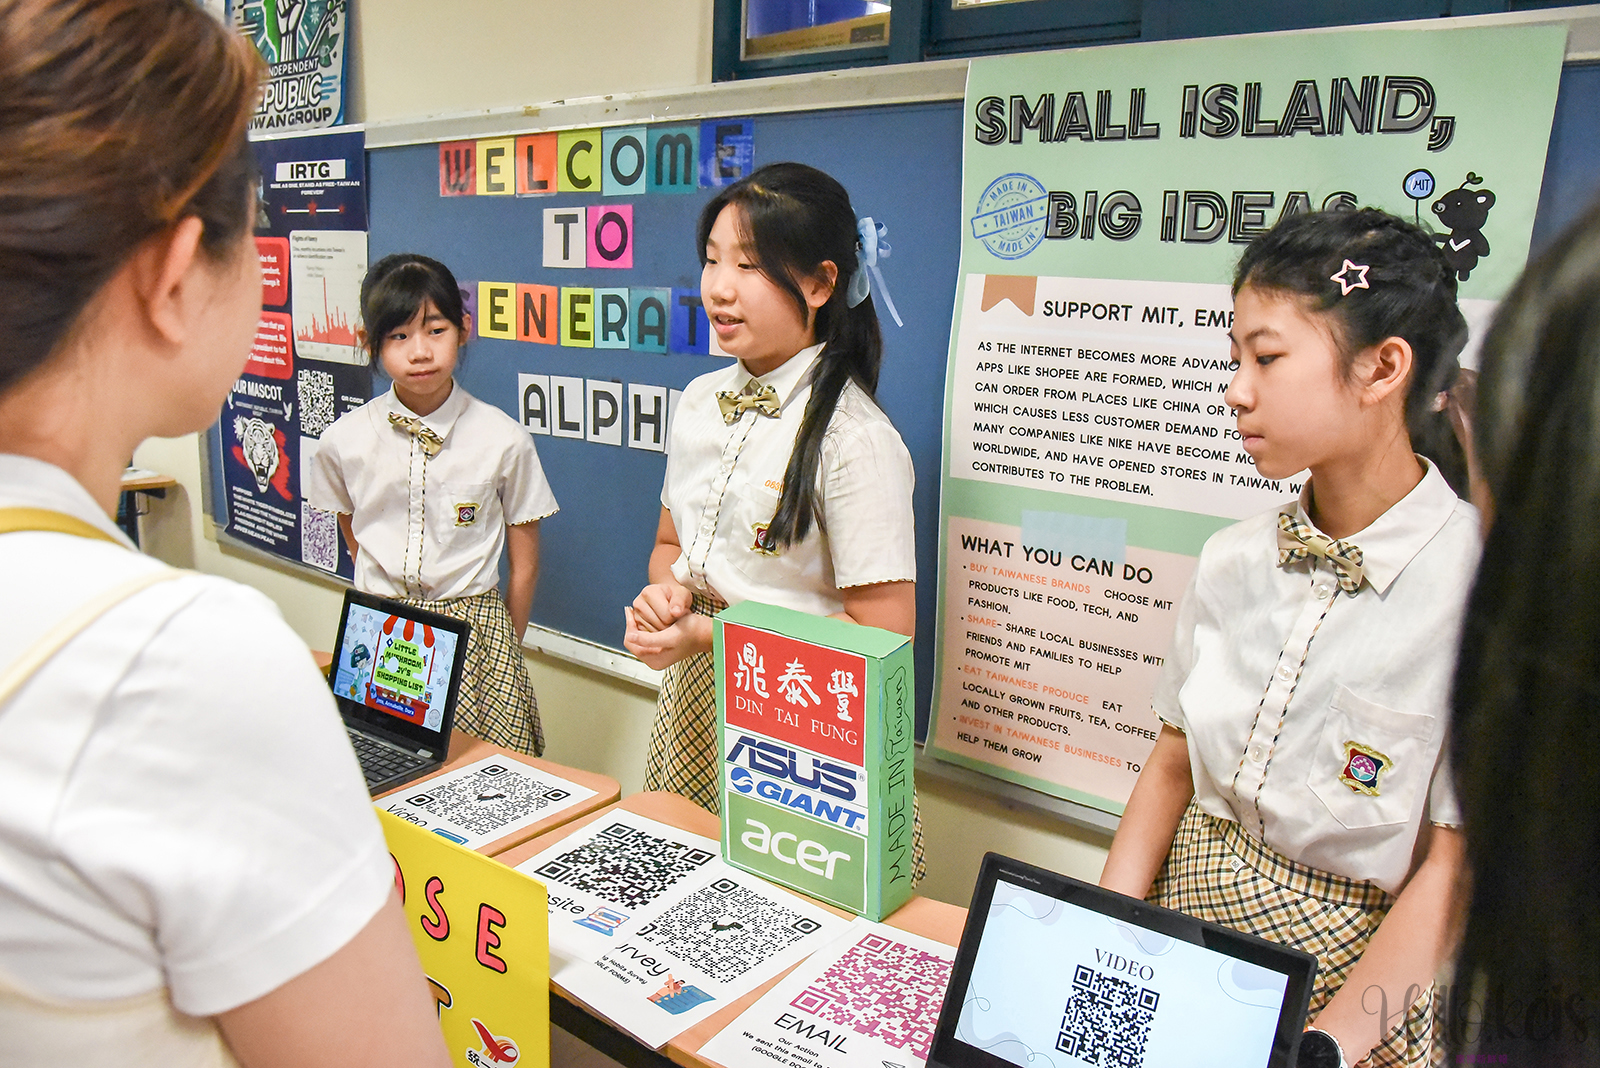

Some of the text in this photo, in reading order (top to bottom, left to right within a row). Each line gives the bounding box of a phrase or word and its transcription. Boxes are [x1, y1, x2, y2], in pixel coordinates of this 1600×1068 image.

[288, 107, 332, 126] GROUP
[975, 75, 1456, 152] SMALL ISLAND,
[290, 161, 331, 179] IRTG
[443, 124, 743, 192] WELCOME
[990, 181, 1027, 201] MADE IN
[1413, 178, 1430, 191] MIT
[993, 205, 1034, 228] TAIWAN
[1045, 189, 1143, 242] BIG
[554, 211, 628, 261] TO
[998, 231, 1036, 252] MADE IN
[460, 288, 703, 348] ENERAT
[1043, 300, 1133, 323] SUPPORT
[1142, 306, 1184, 328] MIT,
[978, 341, 992, 352] AS
[996, 342, 1017, 354] THE
[1020, 344, 1072, 359] INTERNET
[1077, 348, 1136, 364] BECOMES
[1140, 354, 1177, 367] MORE
[247, 381, 283, 401] MASCOT
[976, 361, 1004, 373] APPS
[1008, 364, 1031, 376] LIKE
[1035, 366, 1080, 380] SHOPEE
[1084, 370, 1108, 383] ARE
[1112, 373, 1166, 390] FORMED,
[1171, 379, 1212, 393] WHICH
[523, 383, 662, 444] ALPH
[975, 382, 999, 393] CAN
[1002, 385, 1039, 398] ORDER
[1043, 387, 1077, 401] FROM
[1081, 391, 1128, 406] PLACES
[1133, 397, 1157, 409] LIKE
[1162, 399, 1201, 413] CHINA
[1206, 404, 1225, 416] OR
[974, 402, 1009, 415] WHICH
[1013, 405, 1058, 420] CAUSES
[1062, 410, 1089, 423] LESS
[1094, 414, 1160, 431] CUSTOMER
[1165, 422, 1219, 439] DEMAND
[973, 421, 1005, 434] MANY
[1009, 425, 1075, 443] COMPANIES
[1080, 432, 1103, 446] LIKE
[1108, 435, 1132, 449] NIKE
[1137, 440, 1171, 455] HAVE
[1176, 445, 1230, 462] BECOME
[972, 461, 1154, 496] CONTRIBUTES TO THE PROBLEM.
[973, 441, 1040, 460] WORLDWIDE,
[1044, 450, 1068, 462] AND
[1072, 452, 1104, 467] HAVE
[1108, 458, 1155, 475] OPENED
[1160, 464, 1207, 481] STORES
[1212, 472, 1224, 483] IN
[1229, 474, 1283, 494] TAIWAN,
[961, 533, 1154, 585] WHAT YOU CAN DO
[968, 580, 1139, 623] PRODUCTS LIKE FOOD, TECH, AND
[969, 562, 1174, 611] BUY TAIWANESE BRANDS CHOOSE MIT
[968, 597, 1011, 615] FASHION.
[394, 643, 417, 656] LITTLE
[965, 648, 1031, 672] PROMOTE MIT
[966, 631, 1122, 676] FRIENDS AND FAMILIES TO HELP
[1005, 623, 1036, 638] SHARE
[1040, 630, 1074, 647] LOCAL
[1078, 640, 1138, 661] BUSINESSES
[376, 670, 408, 687] SHOPPING
[408, 680, 423, 692] LIST
[734, 642, 859, 723] 鼎泰豐
[963, 664, 1123, 714] EAT TAIWANESE PRODUCE EAT
[735, 695, 858, 746] DIN TAI FUNG
[961, 698, 1071, 737] AND OTHER PRODUCTS.
[962, 681, 1006, 700] LOCALLY
[1009, 693, 1045, 711] GROWN
[1049, 703, 1084, 723] FRUITS,
[1087, 714, 1111, 730] TEA,
[957, 731, 1042, 764] HELP THEM GROW
[959, 714, 1141, 773] INVEST IN TAIWANESE BUSINESSES TO
[725, 735, 857, 802] ASUS
[887, 676, 906, 884] MADE IN Taiwan
[756, 779, 865, 830] GIANT
[740, 818, 851, 880] acer
[394, 855, 508, 975] SE
[548, 893, 585, 914] site
[1095, 947, 1155, 981] VIDEO
[742, 1031, 754, 1039] We
[755, 1038, 774, 1048] sent
[774, 1045, 789, 1055] this
[791, 1053, 813, 1065] email
[774, 1012, 847, 1054] EMAIL
[778, 1037, 819, 1058] Our Action
[751, 1045, 789, 1065] (GOOGLE
